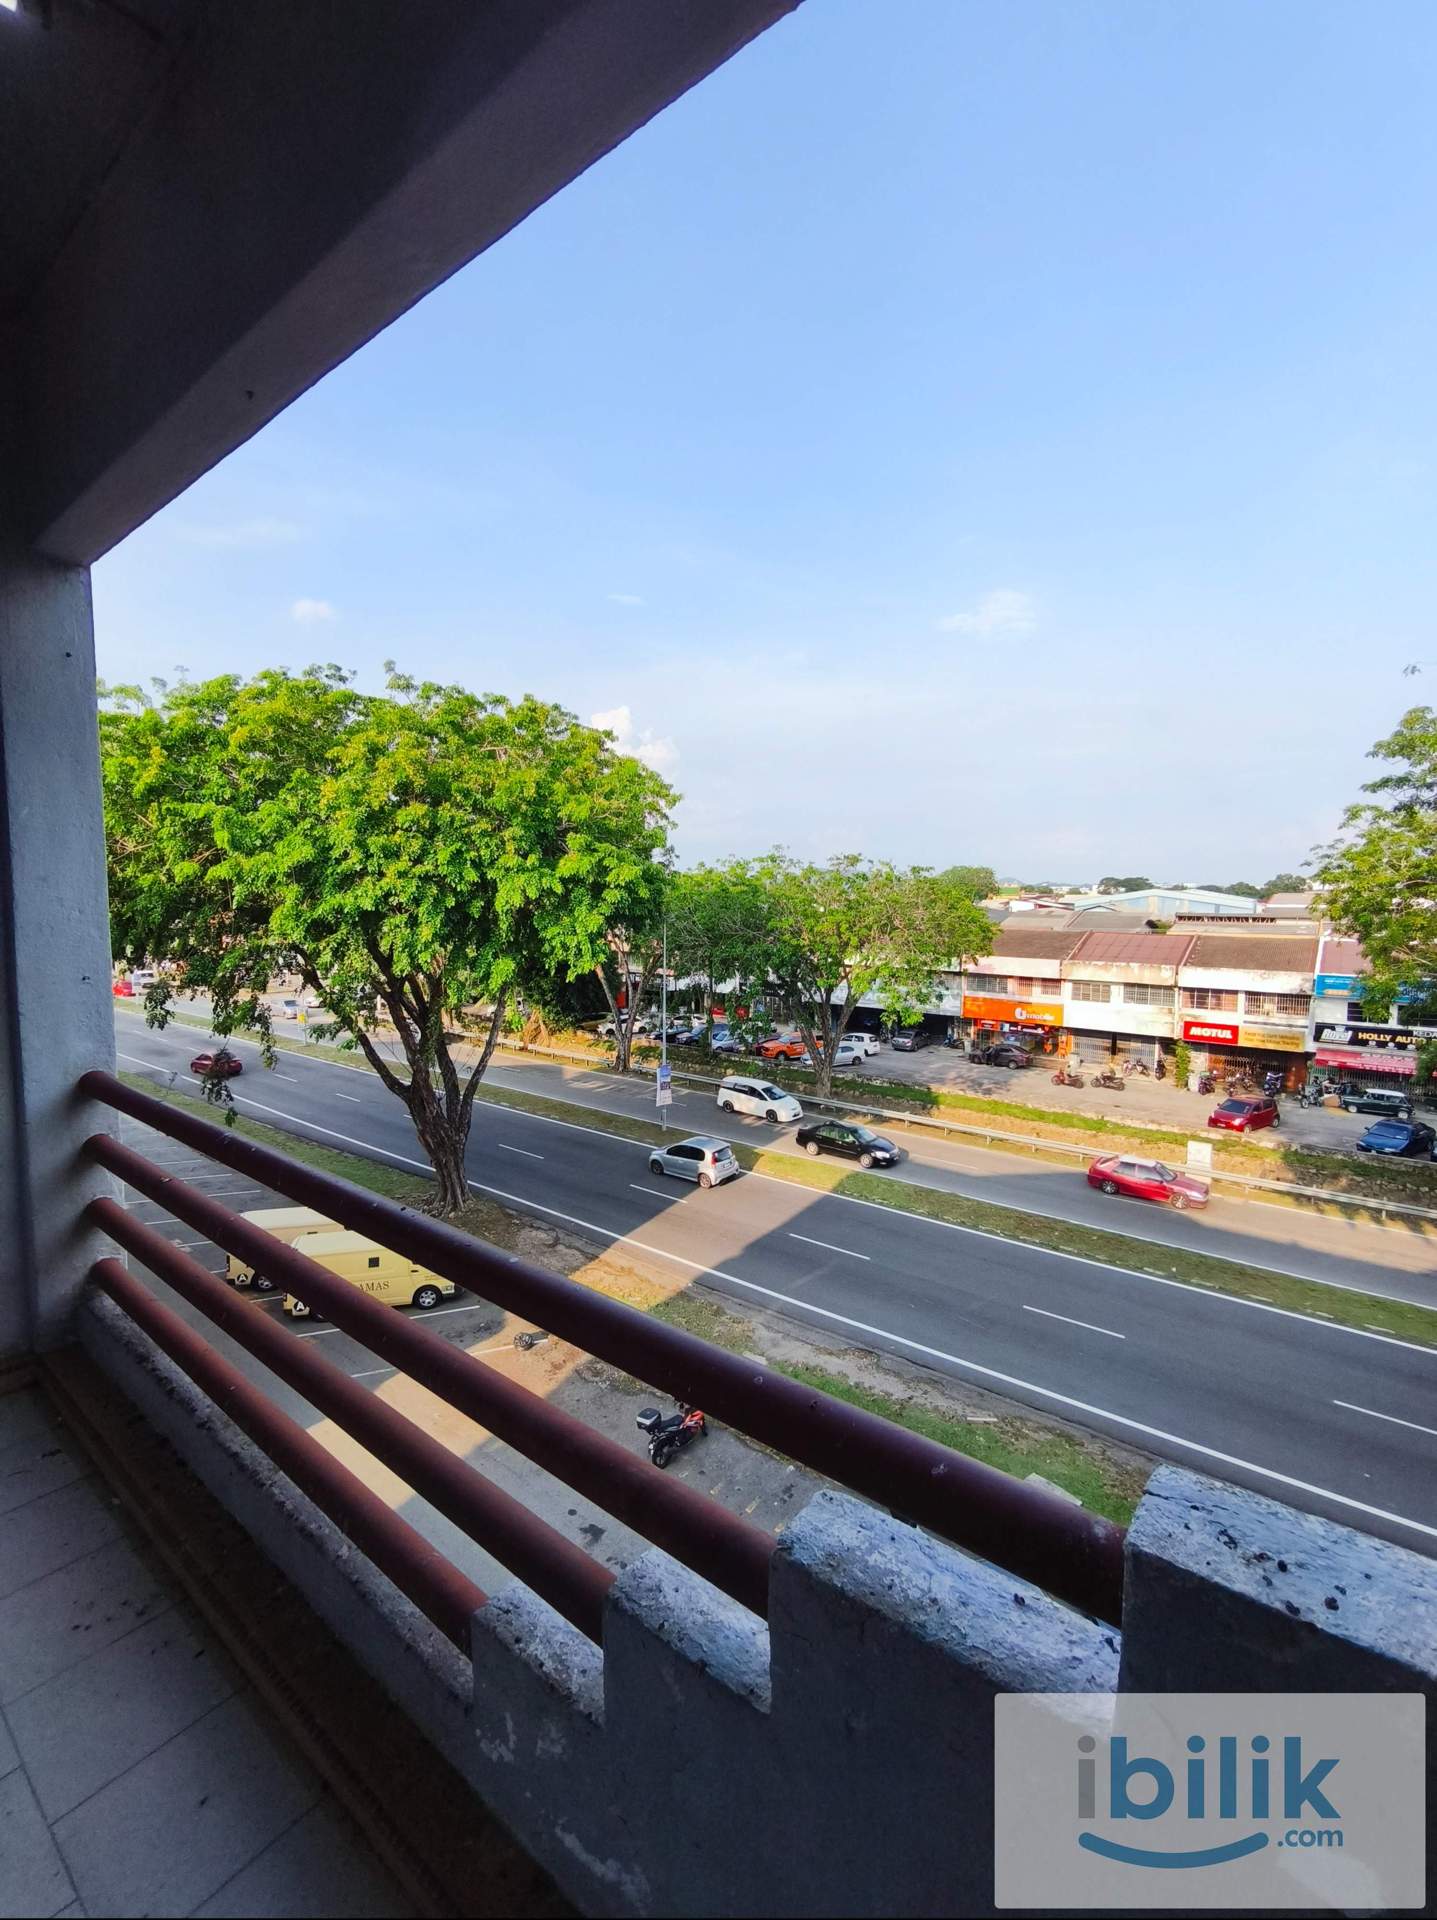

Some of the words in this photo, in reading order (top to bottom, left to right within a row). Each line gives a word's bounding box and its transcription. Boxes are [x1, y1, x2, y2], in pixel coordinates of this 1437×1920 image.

[1189, 1027, 1232, 1039] MOTUL
[1358, 1032, 1393, 1042] HOLLY
[238, 1274, 247, 1282] A
[296, 1301, 305, 1311] A
